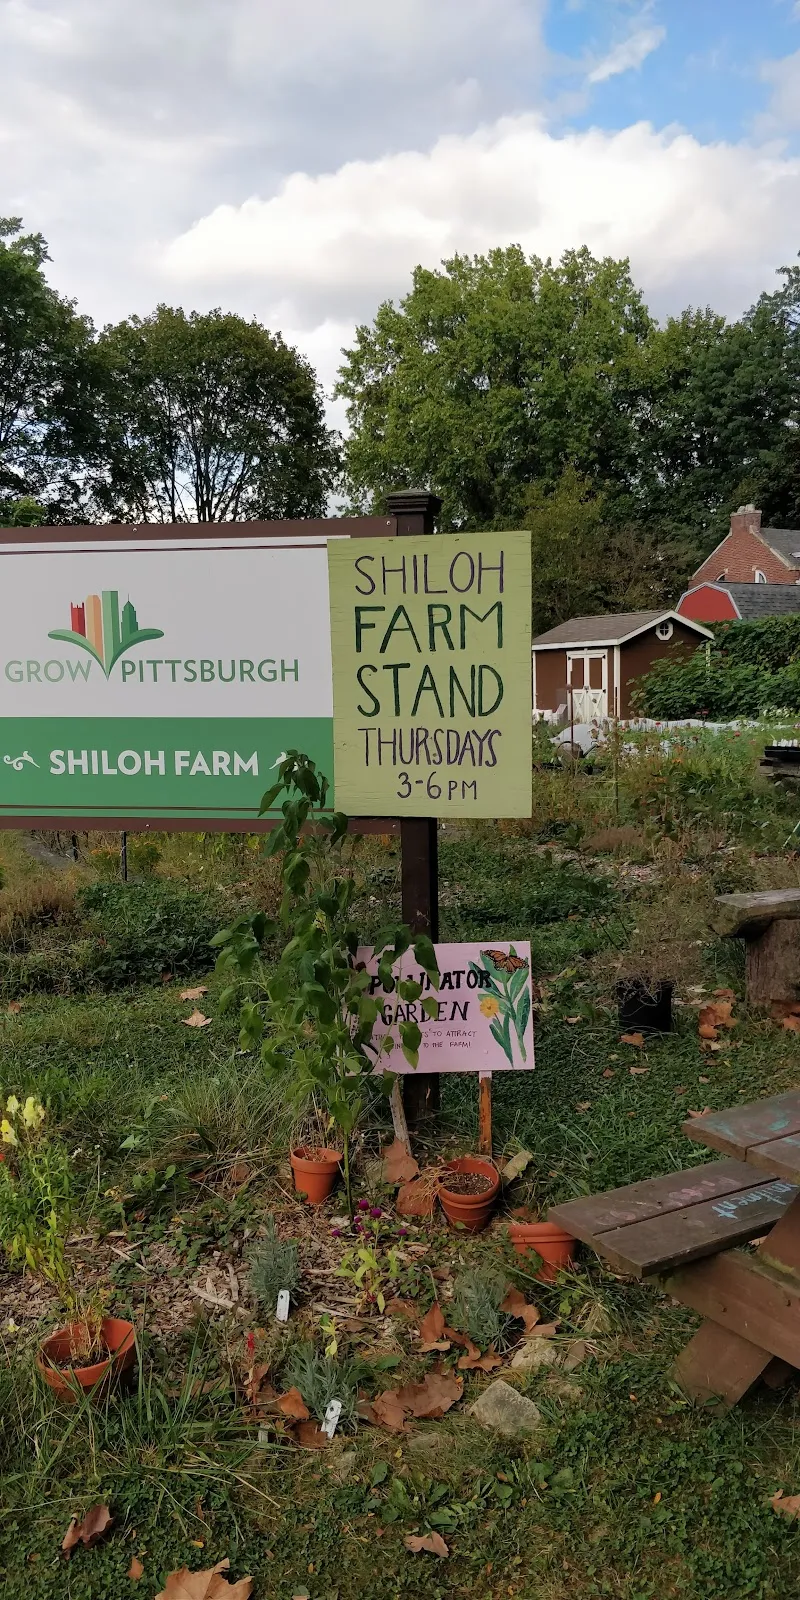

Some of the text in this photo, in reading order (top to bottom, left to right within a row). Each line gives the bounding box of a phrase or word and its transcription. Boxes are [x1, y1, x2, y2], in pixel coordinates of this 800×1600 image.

[354, 550, 504, 596] SHILOH
[354, 601, 503, 653] FARM
[4, 659, 299, 683] GROW PITTSBURGH
[356, 662, 504, 718] STAND
[50, 750, 259, 776] SHILOH FARM
[357, 727, 502, 768] THURSDAYS
[368, 969, 492, 995] POIATOR
